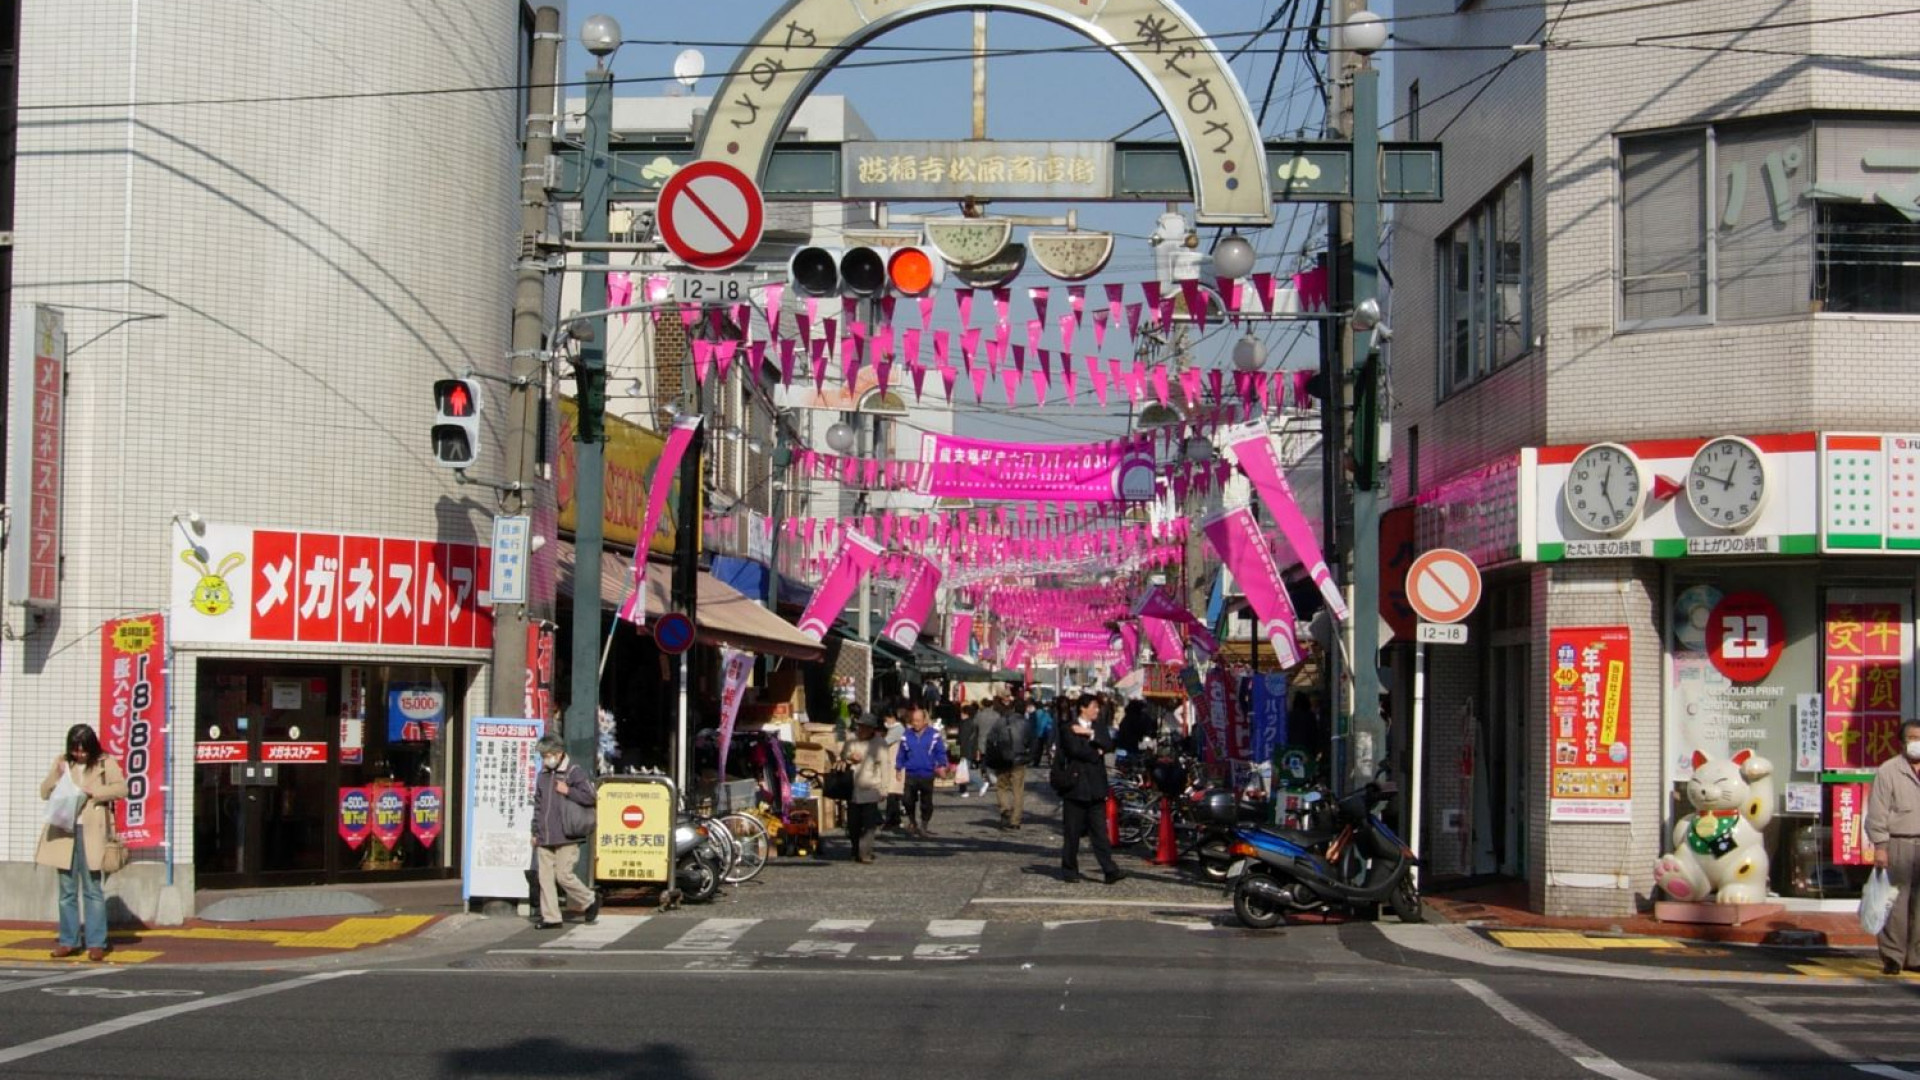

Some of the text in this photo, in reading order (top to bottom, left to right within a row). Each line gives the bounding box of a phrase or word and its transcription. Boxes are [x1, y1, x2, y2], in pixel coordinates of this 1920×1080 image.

[681, 279, 742, 299] 12-18
[1722, 445, 1733, 454] 12
[1739, 449, 1744, 457] 1
[1600, 452, 1610, 461] 12
[1616, 454, 1621, 463] 1
[1708, 452, 1718, 462] 11
[1586, 458, 1596, 468] 11
[1748, 460, 1757, 469] 2
[1625, 467, 1633, 476] 2
[1697, 465, 1711, 476] 10
[38, 362, 56, 596] メガネストアー
[1577, 471, 1588, 481] 10
[1753, 476, 1761, 485] 3
[1629, 483, 1637, 492] 3
[1696, 480, 1704, 489] 9
[1574, 485, 1583, 494] 9
[1700, 495, 1709, 504] 8
[1750, 492, 1758, 501] 4
[1577, 501, 1586, 510] 8
[1626, 498, 1634, 507] 4
[1616, 510, 1624, 519] 5
[1712, 508, 1720, 517] 7
[1740, 506, 1749, 515] 5
[1589, 512, 1597, 521] 7
[1725, 511, 1734, 520] 6
[1602, 516, 1610, 525] 6
[1566, 540, 1642, 556] ただいまの時間
[1689, 537, 1767, 552] 仕上がりの時間
[1423, 628, 1460, 639] 12-18
[1722, 615, 1769, 658] 23
[1827, 608, 1863, 765] 受付中
[1865, 608, 1900, 763] 年賀状
[1756, 686, 1785, 696] PRINT
[1741, 700, 1769, 710] PRINT
[269, 745, 320, 759] メガネストアー
[601, 833, 665, 847] 歩行者天国
[608, 868, 655, 878] 松原商店街
